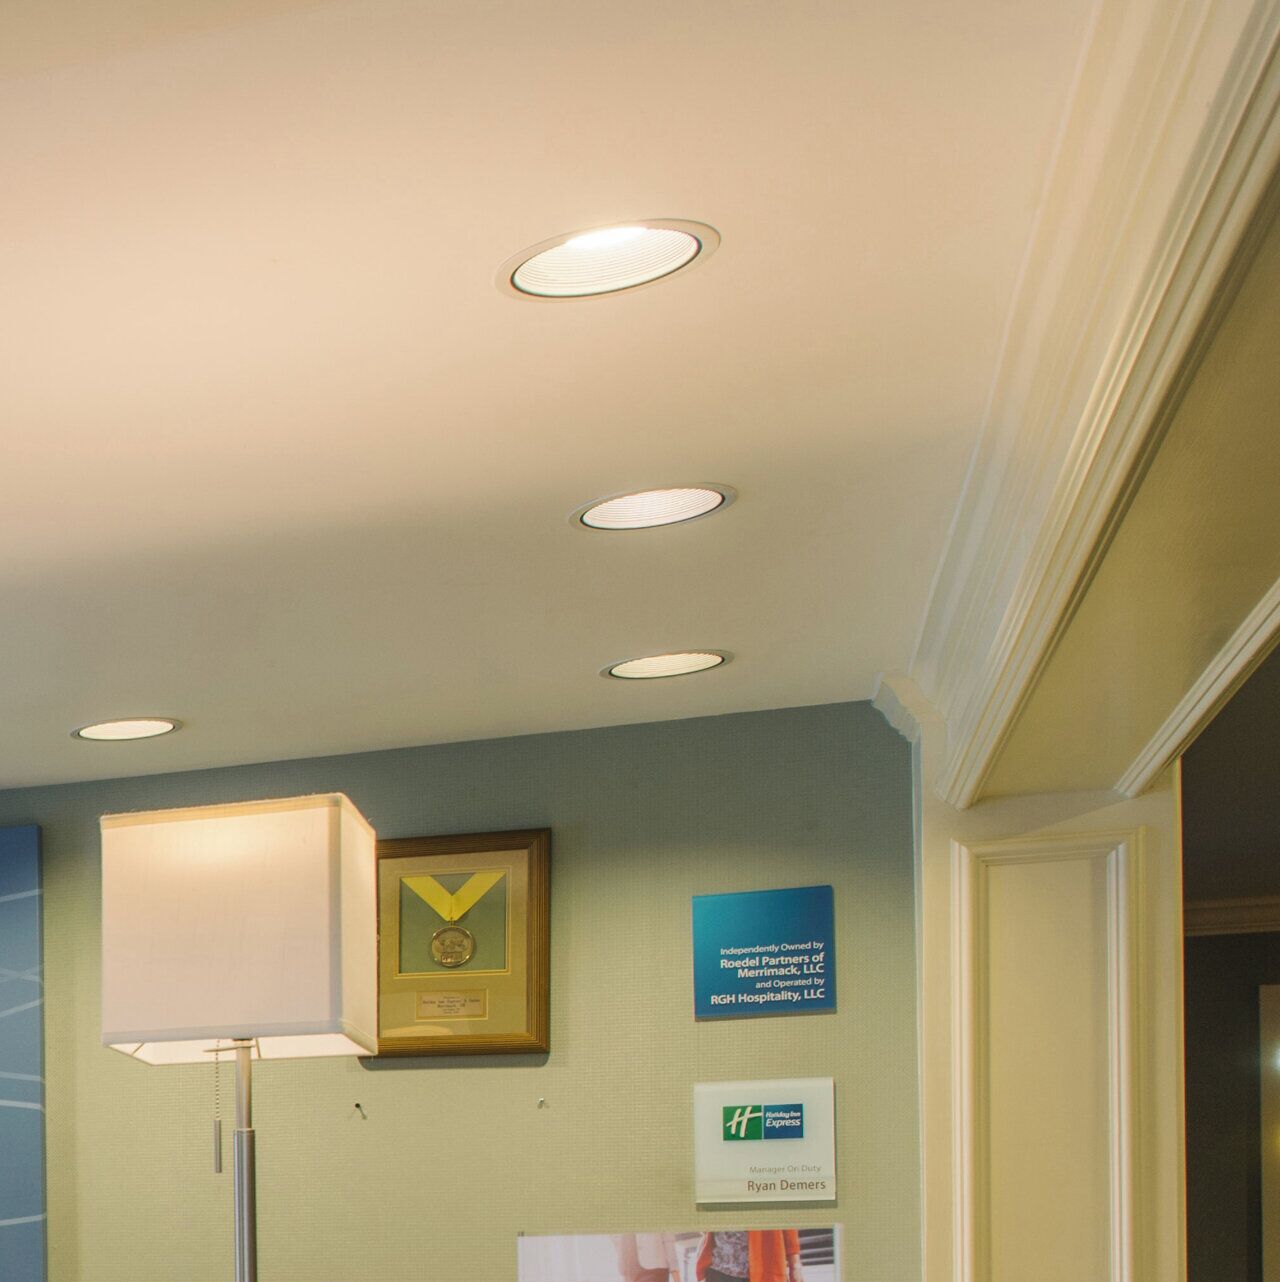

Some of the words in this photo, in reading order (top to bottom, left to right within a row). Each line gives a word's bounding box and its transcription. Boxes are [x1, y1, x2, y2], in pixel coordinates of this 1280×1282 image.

[720, 944, 780, 956] Independently
[781, 942, 811, 952] Owned
[813, 941, 824, 950] by
[720, 957, 760, 969] Roedel
[762, 955, 810, 966] Partners
[812, 952, 825, 963] of
[737, 965, 801, 978] Merrimack,
[804, 963, 825, 974] LLC
[755, 980, 772, 989] and
[773, 978, 812, 988] Operated
[814, 977, 825, 986] by
[711, 994, 736, 1005] RGH
[738, 991, 801, 1004] Hospitality,
[804, 989, 825, 999] LLC
[766, 1111, 790, 1119] Holiday
[766, 1118, 801, 1128] Express
[749, 1165, 785, 1175] Manager
[787, 1165, 799, 1173] On
[801, 1164, 822, 1174] Duty
[747, 1181, 776, 1193] Ryan
[780, 1179, 826, 1191] Demers
